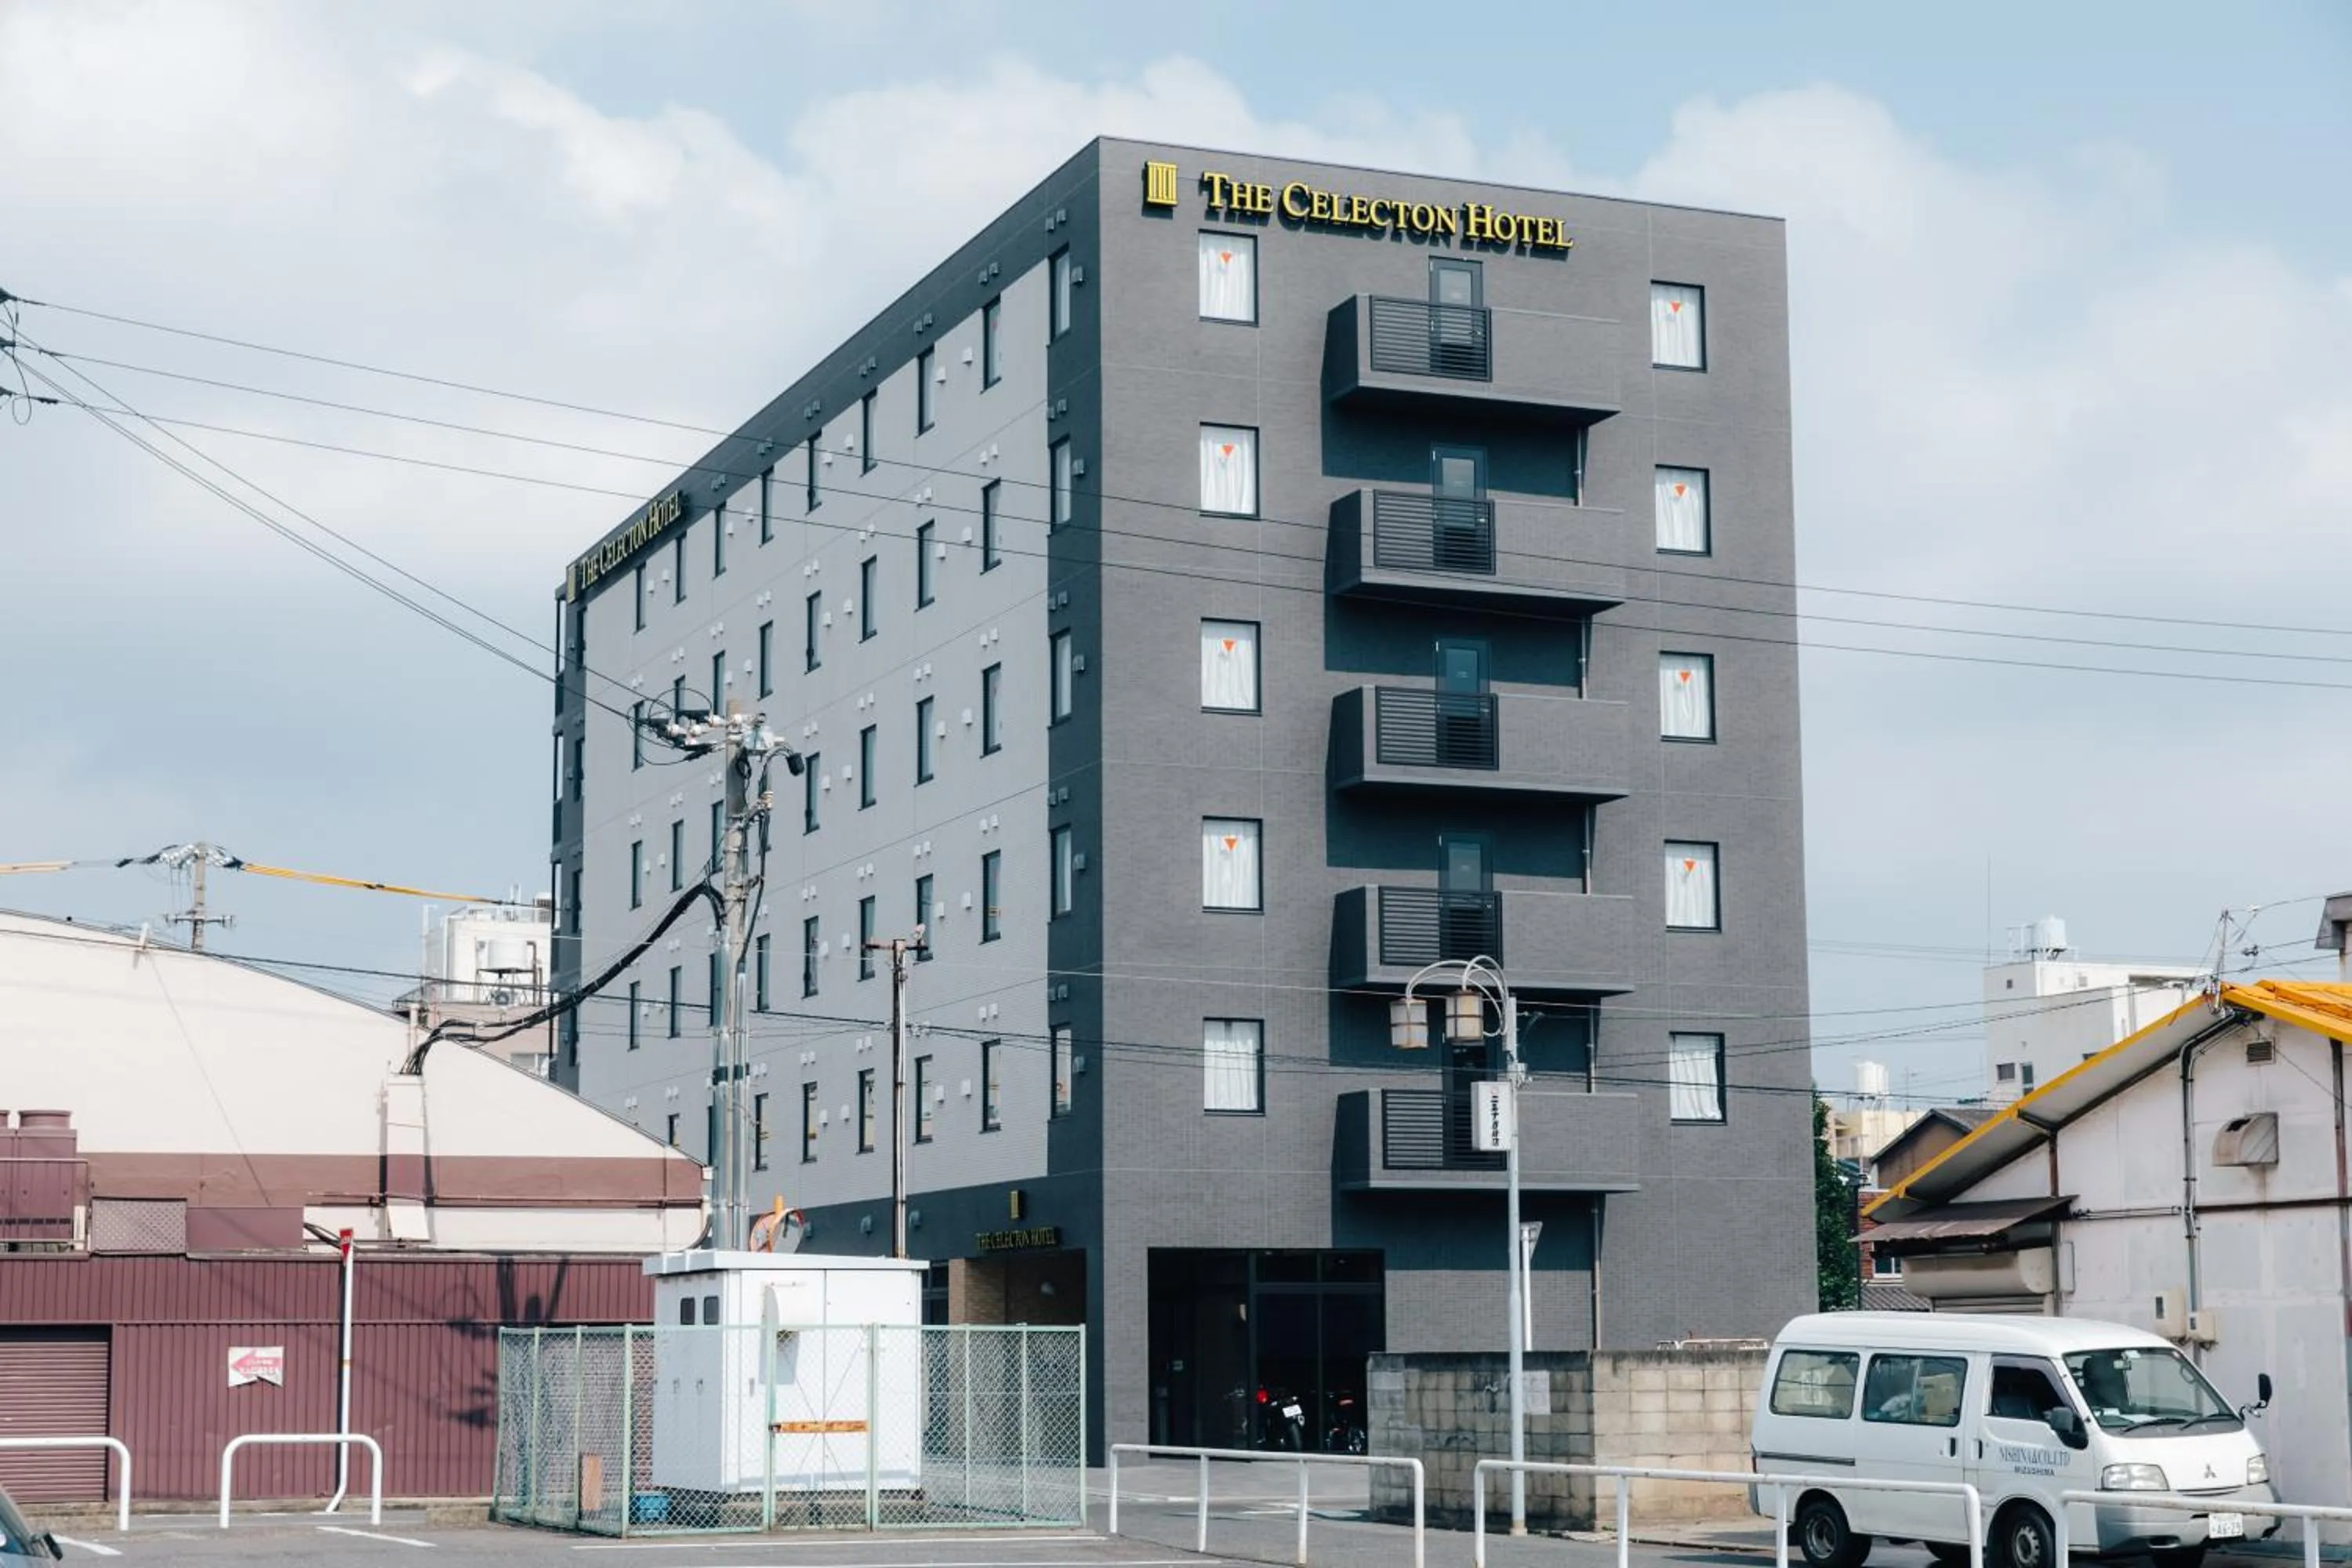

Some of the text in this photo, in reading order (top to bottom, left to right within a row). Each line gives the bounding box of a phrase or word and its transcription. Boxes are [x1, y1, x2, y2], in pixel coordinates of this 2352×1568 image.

[1203, 171, 1573, 248] THE CELECTON HOTEL
[582, 490, 681, 589] THE CELECTON HOTEL
